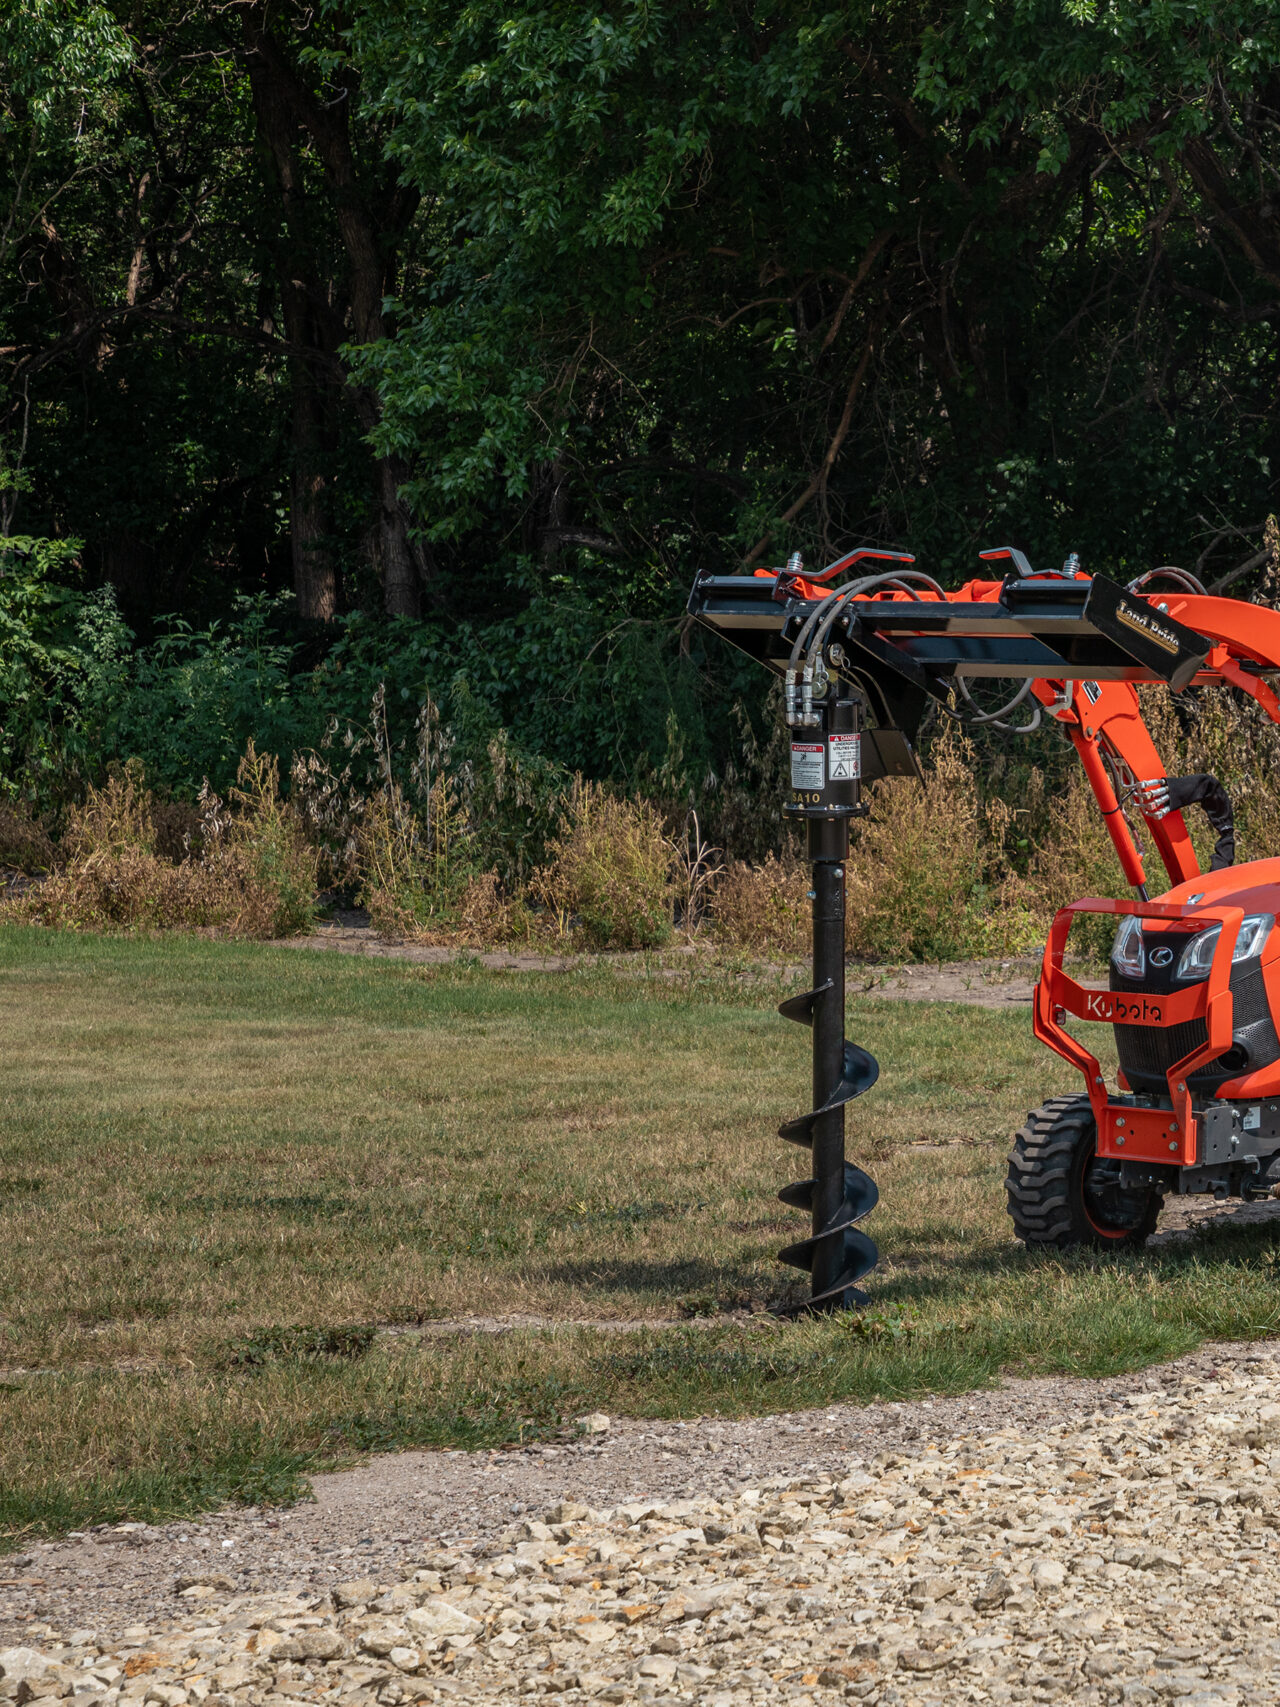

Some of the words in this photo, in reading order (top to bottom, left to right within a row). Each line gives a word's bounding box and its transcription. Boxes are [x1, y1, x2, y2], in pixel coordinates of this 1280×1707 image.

[1119, 599, 1148, 626] Land
[1149, 620, 1180, 647] Pride
[792, 792, 820, 804] SA10
[1088, 994, 1162, 1021] Kubota
